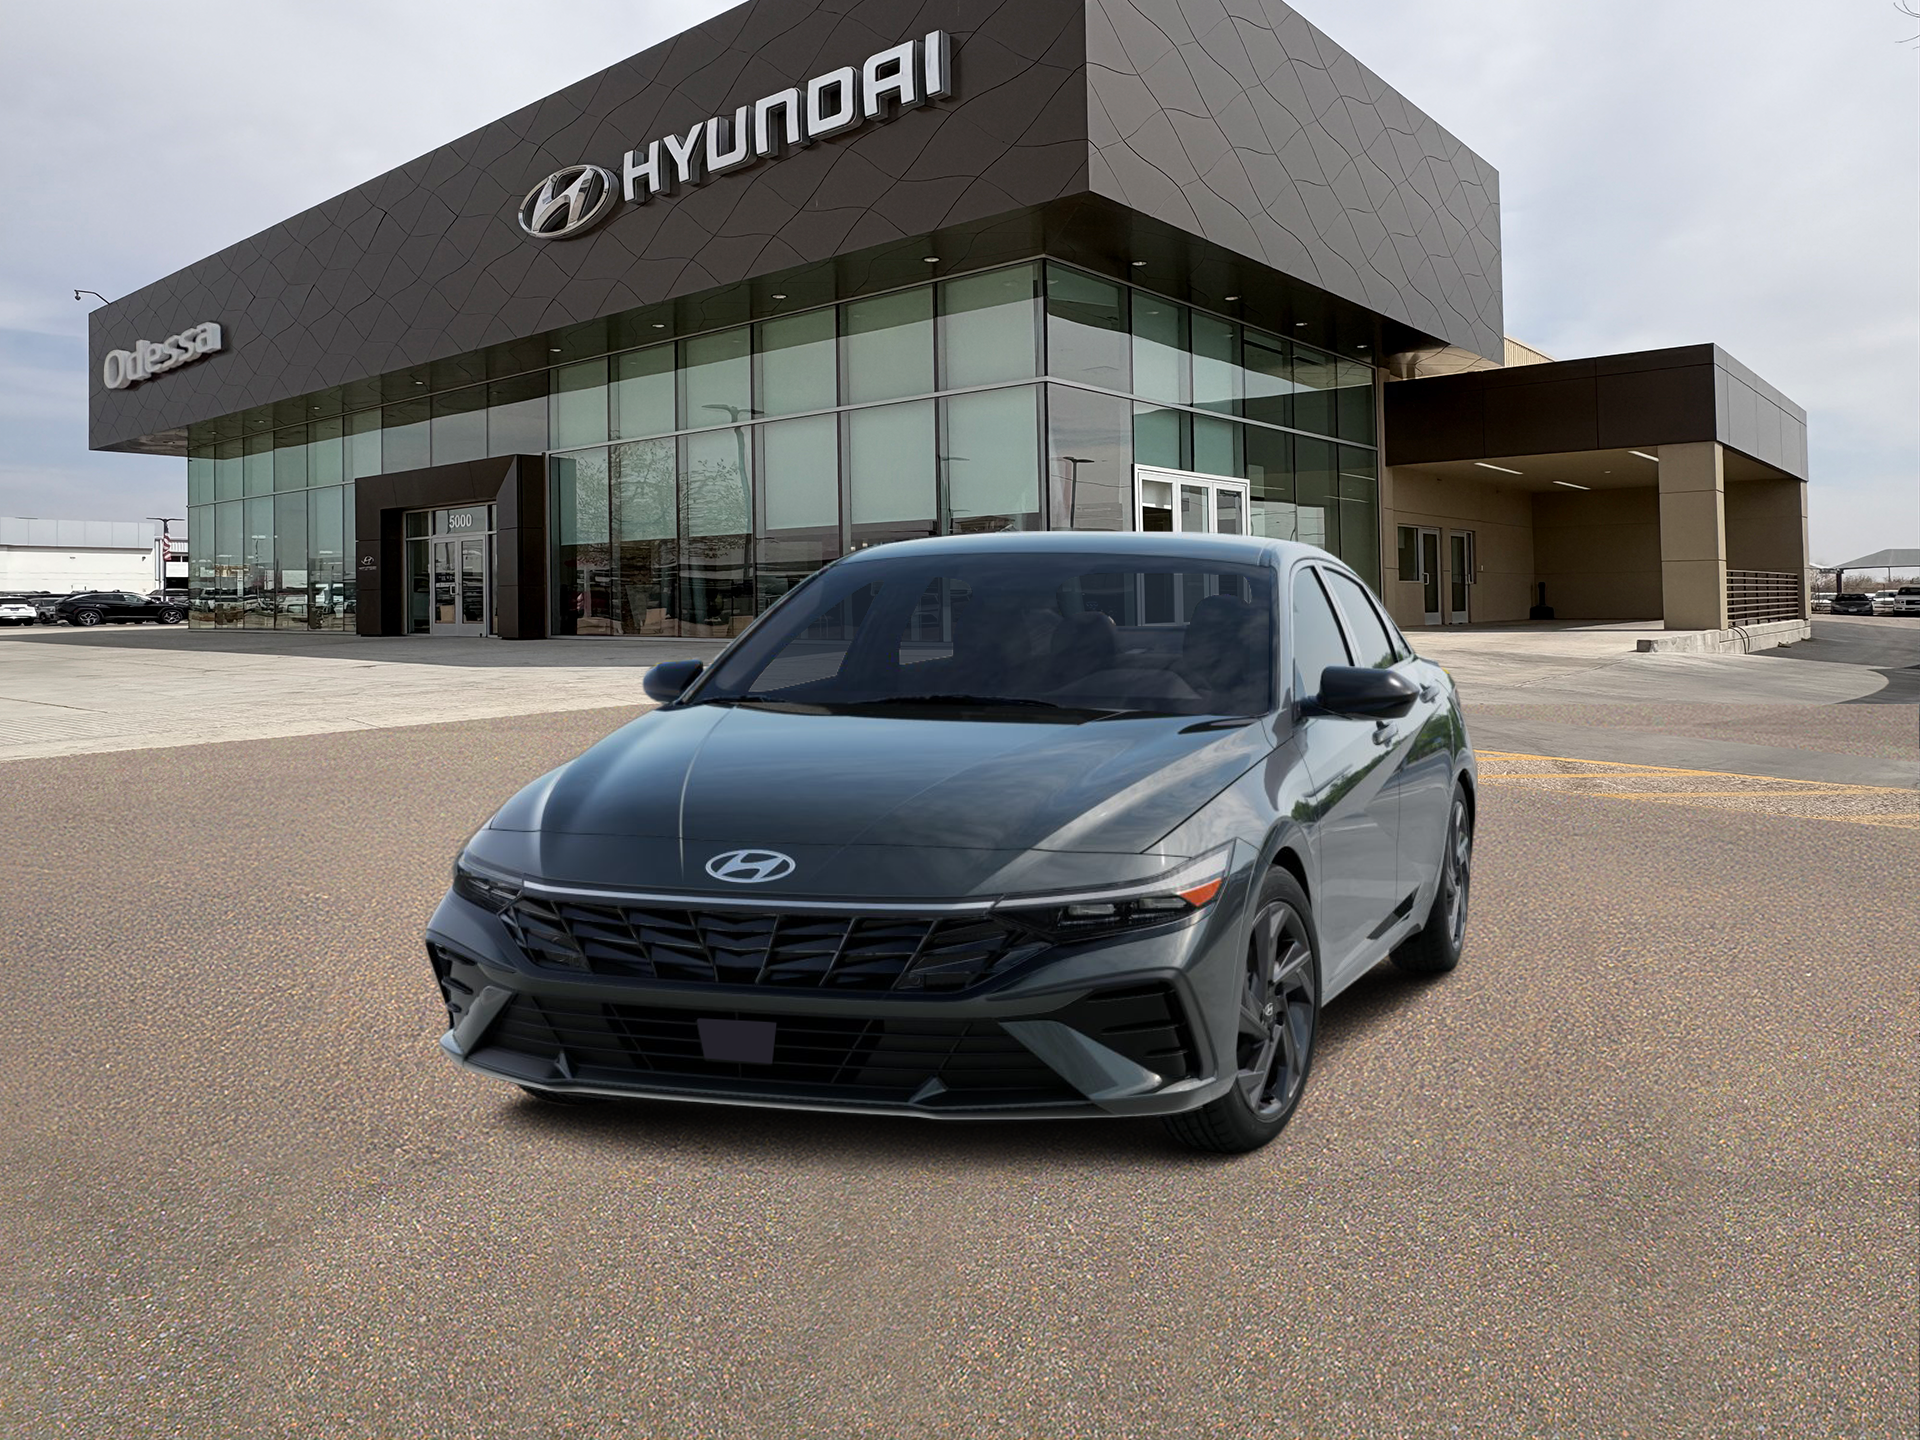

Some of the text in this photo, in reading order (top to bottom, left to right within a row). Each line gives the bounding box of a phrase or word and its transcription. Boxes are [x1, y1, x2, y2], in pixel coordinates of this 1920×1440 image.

[623, 30, 951, 204] HYUNDAI
[103, 321, 222, 389] Odessa
[449, 513, 472, 528] 5000
